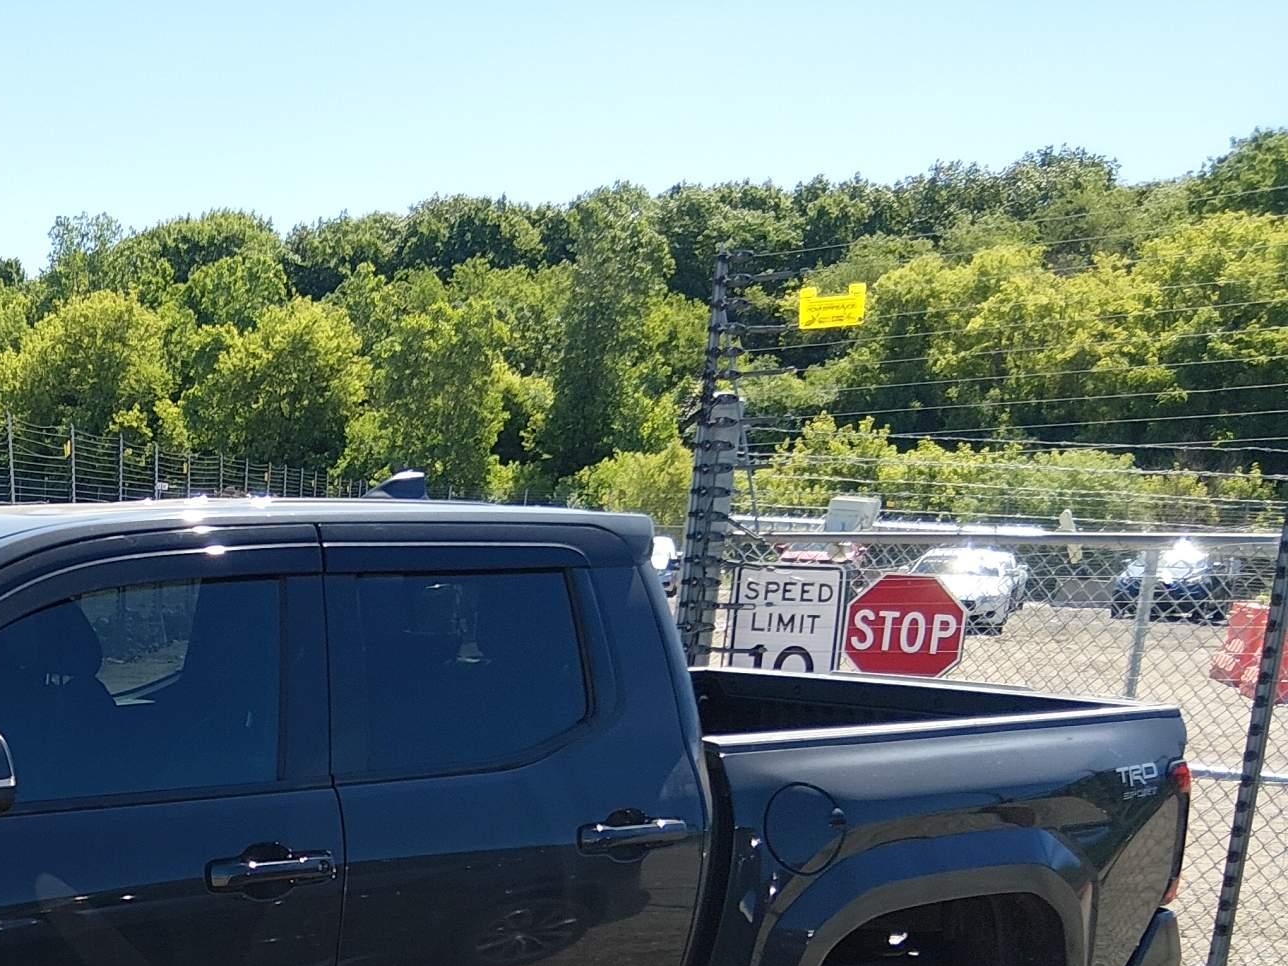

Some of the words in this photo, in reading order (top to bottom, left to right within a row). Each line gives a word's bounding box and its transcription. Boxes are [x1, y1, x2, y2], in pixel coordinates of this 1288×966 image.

[744, 582, 834, 603] SPEED
[751, 613, 821, 635] LIMIT
[850, 610, 957, 655] STOP
[749, 645, 813, 673] 10
[1116, 762, 1158, 786] TRD
